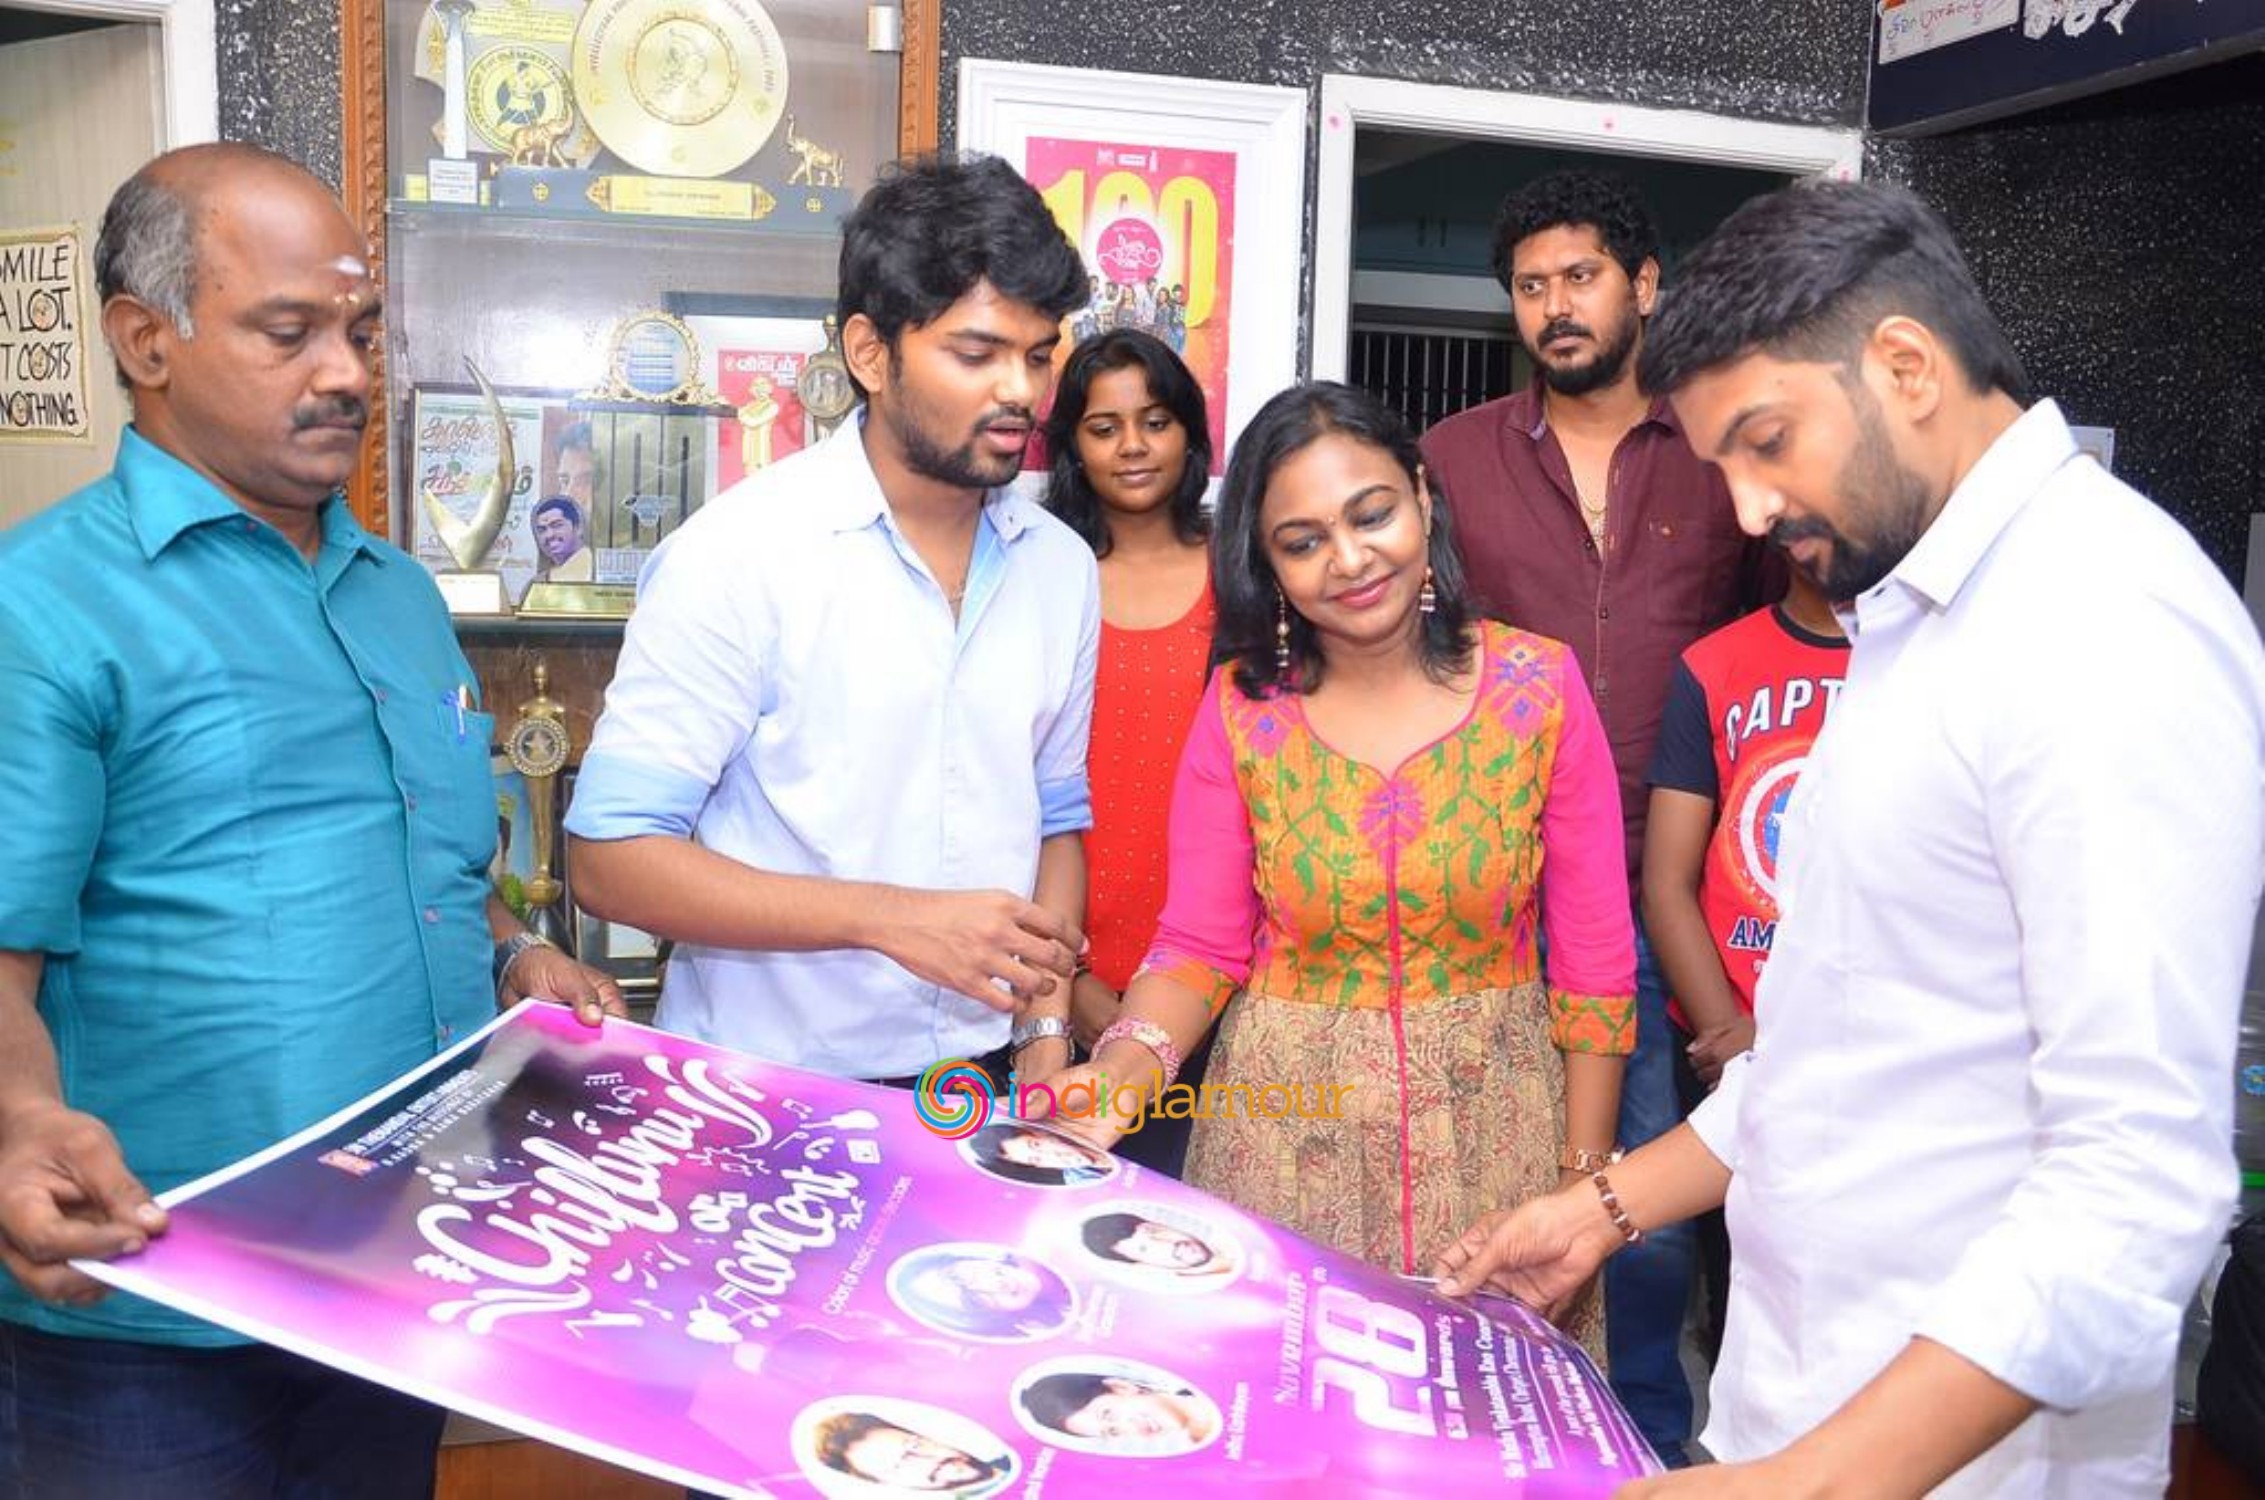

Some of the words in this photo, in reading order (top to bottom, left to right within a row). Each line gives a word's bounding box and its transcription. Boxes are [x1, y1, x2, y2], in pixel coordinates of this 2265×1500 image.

[0, 244, 69, 283] MILE
[16, 341, 73, 381] COSTS
[1311, 1284, 1437, 1437] 28
